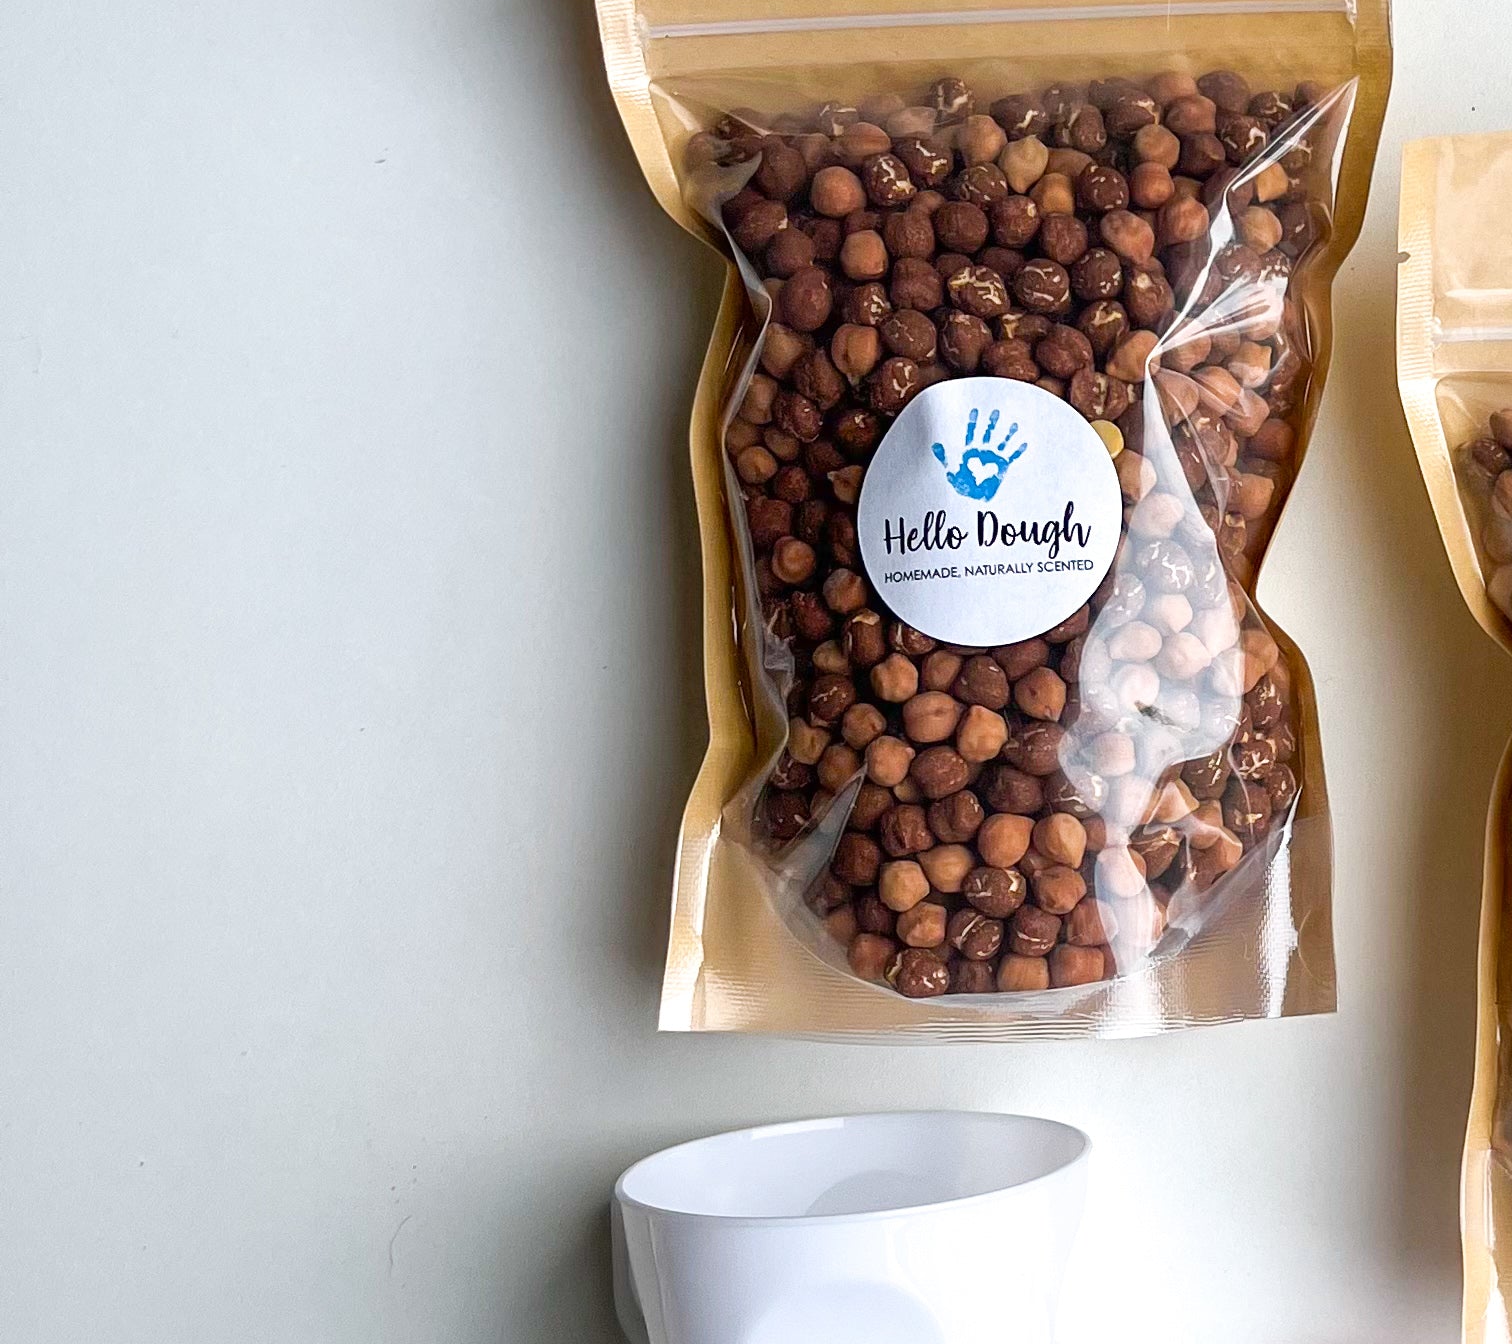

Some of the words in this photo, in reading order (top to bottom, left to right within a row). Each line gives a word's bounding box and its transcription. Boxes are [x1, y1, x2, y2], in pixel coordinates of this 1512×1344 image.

[884, 510, 968, 555] Hello
[977, 501, 1091, 559] Dough
[964, 561, 1033, 577] NATURALLY
[1037, 559, 1094, 573] SCENTED
